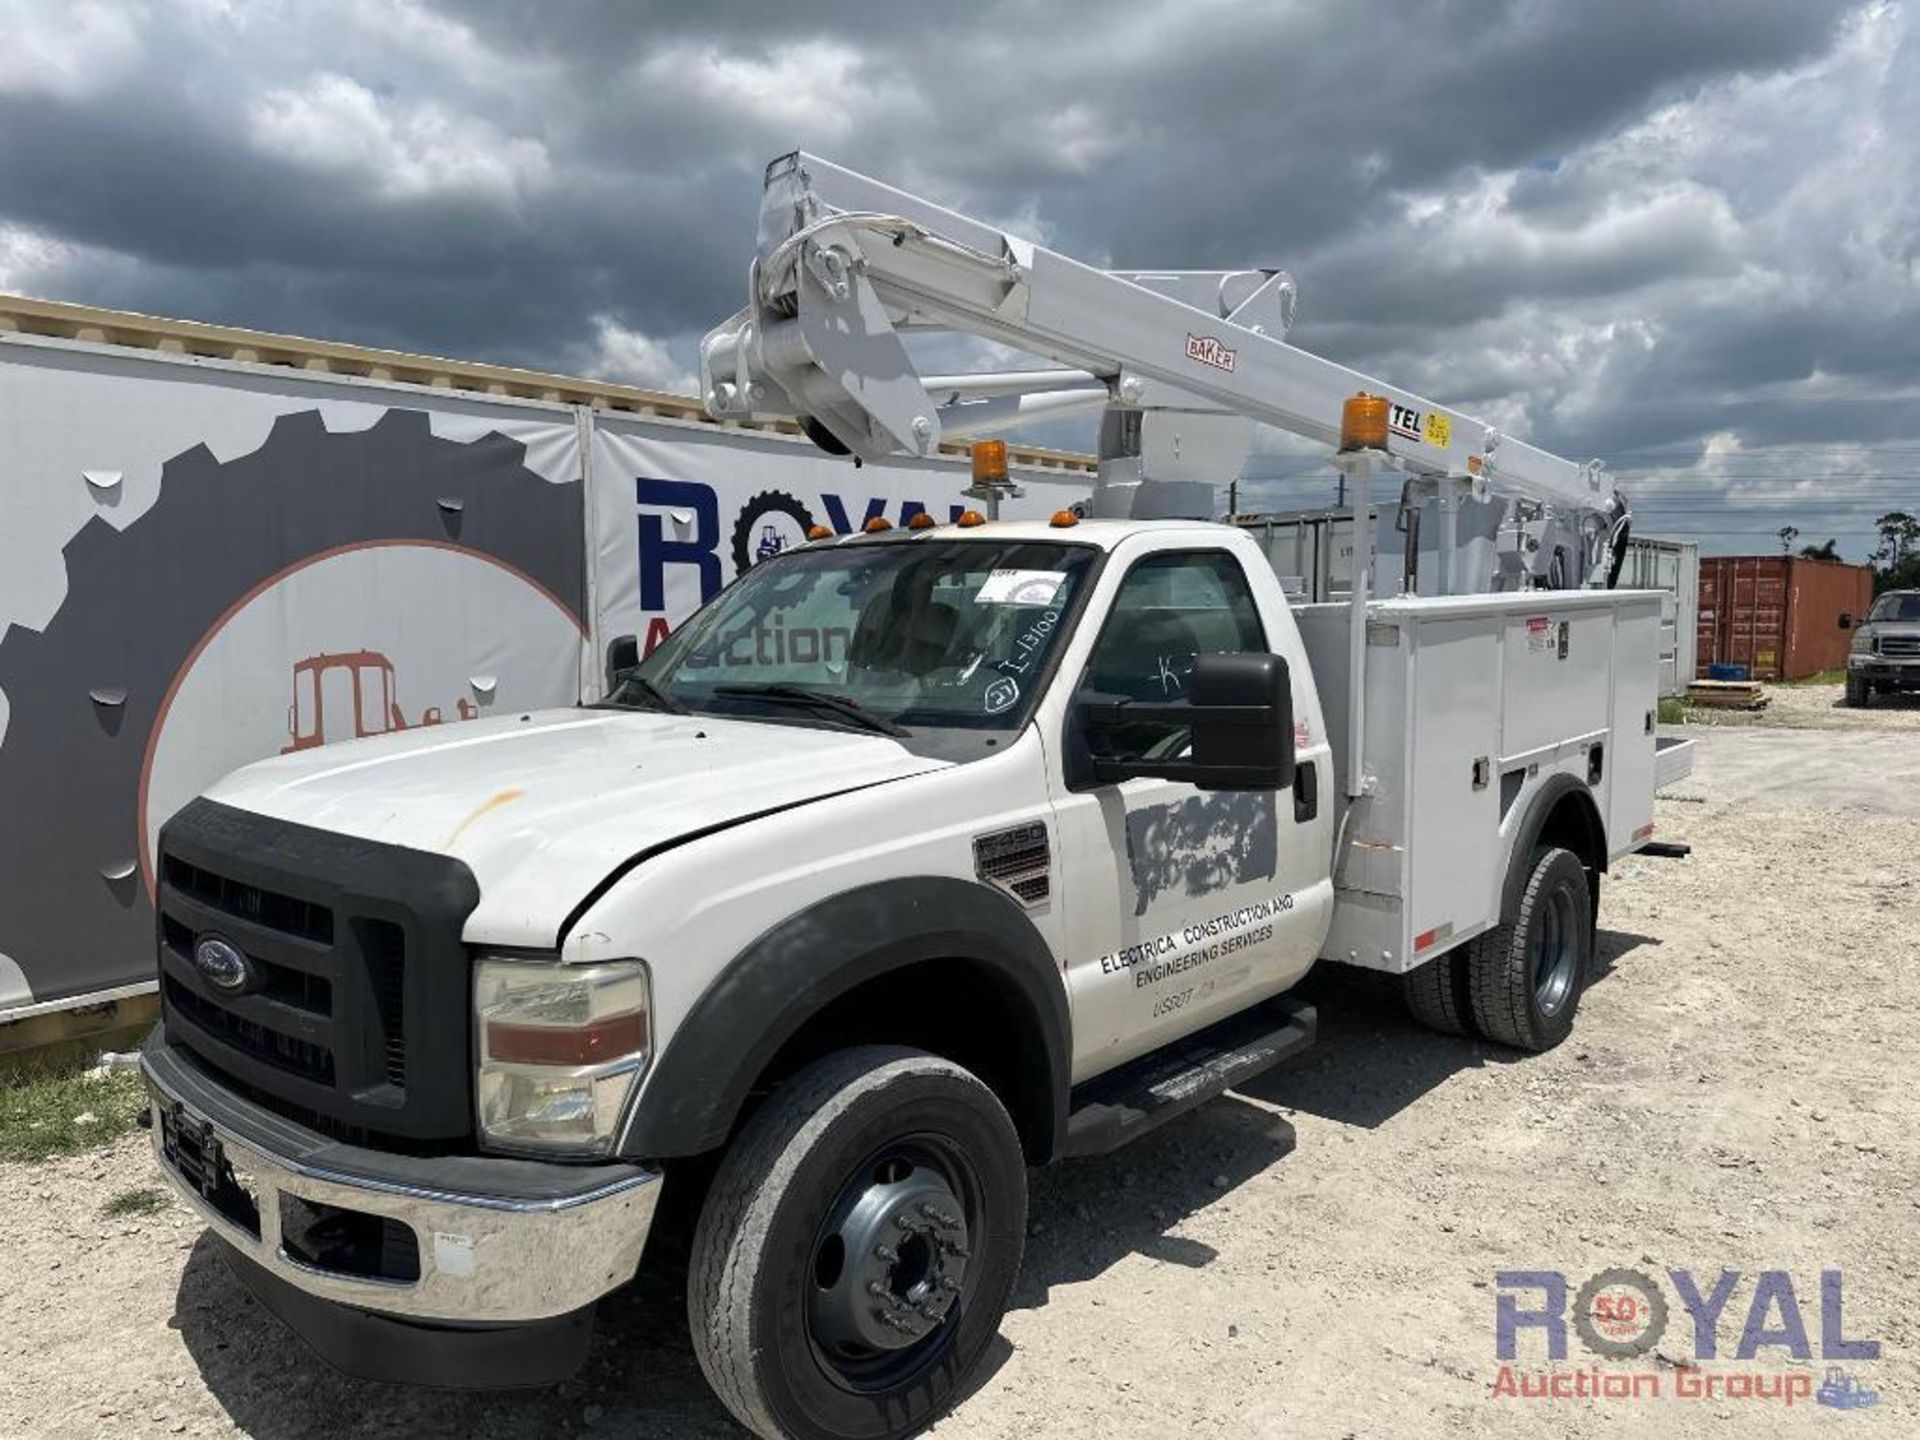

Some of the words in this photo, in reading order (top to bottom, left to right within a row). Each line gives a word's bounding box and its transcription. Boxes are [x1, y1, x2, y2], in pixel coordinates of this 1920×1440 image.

[1190, 340, 1232, 368] BAKER
[1183, 902, 1272, 945] CONSTRUCTION
[1272, 894, 1294, 915] AND
[1136, 945, 1219, 988] ENGINEERING
[1221, 925, 1273, 957] SERVICES
